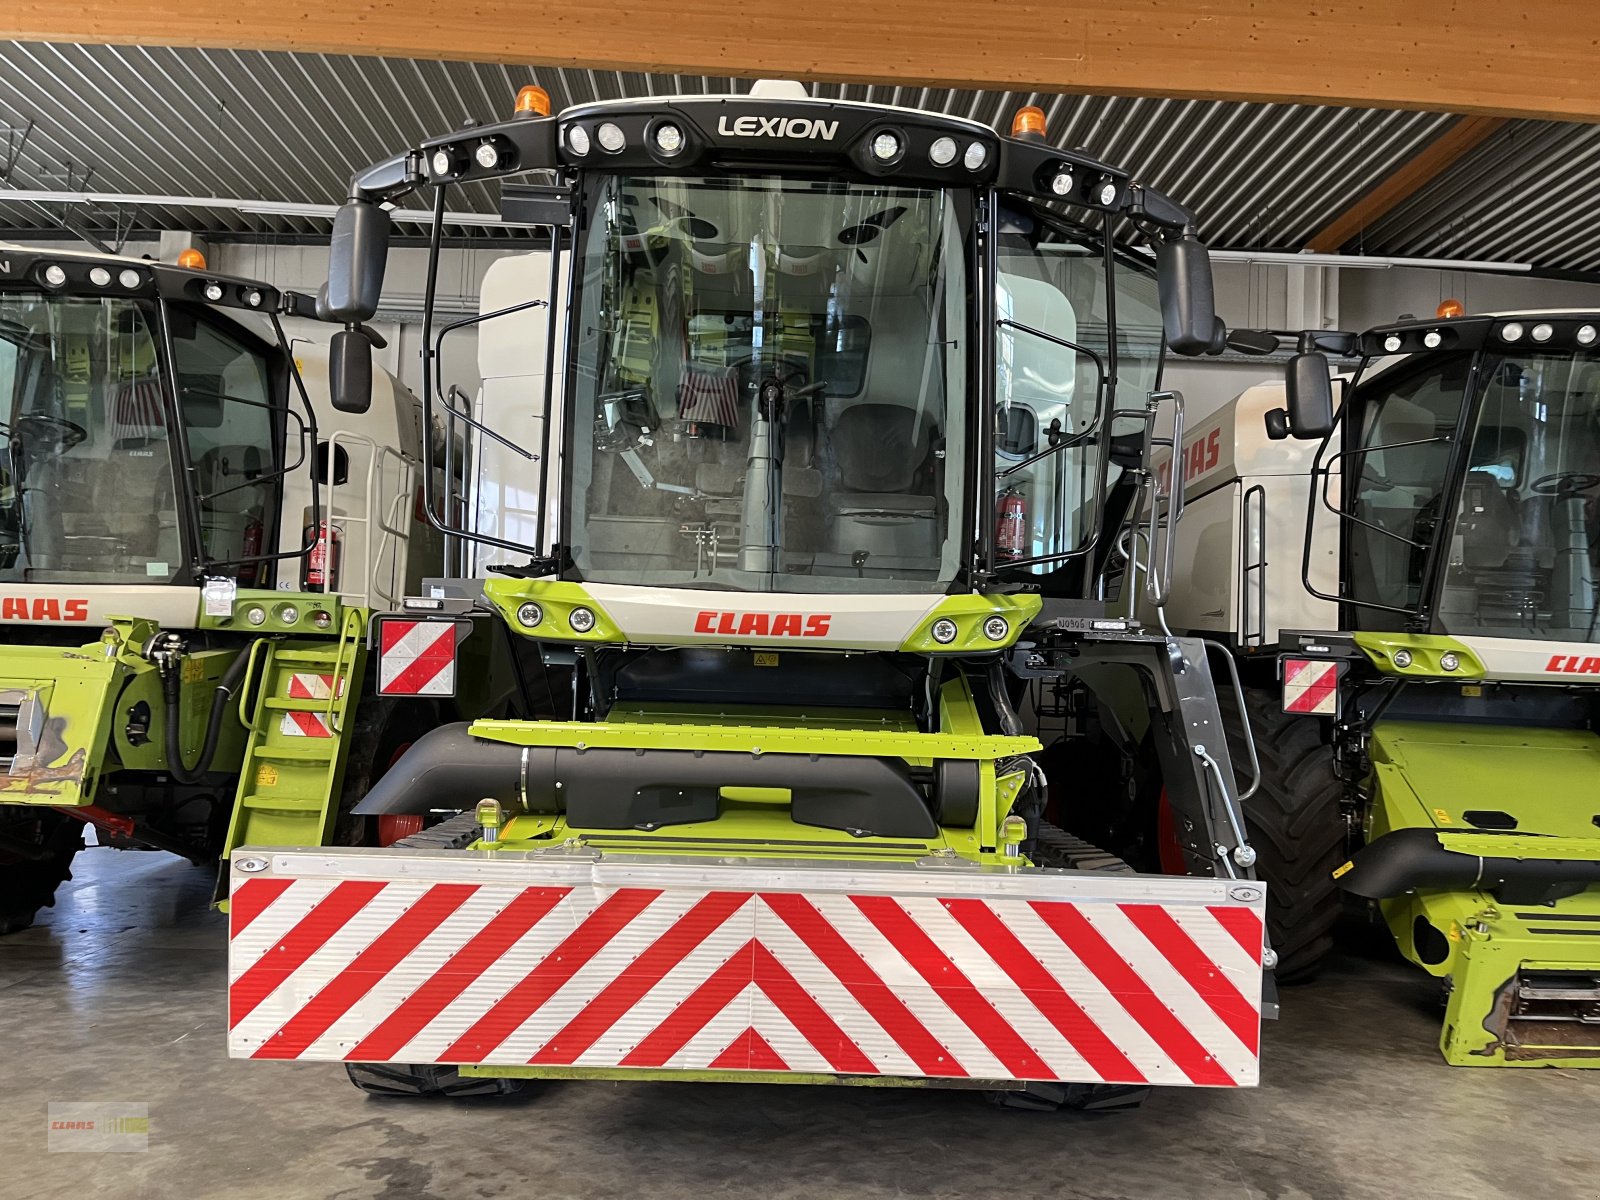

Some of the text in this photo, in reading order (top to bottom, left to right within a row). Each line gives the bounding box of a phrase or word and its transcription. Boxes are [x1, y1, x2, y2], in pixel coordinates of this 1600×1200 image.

[717, 116, 839, 140] LEXION
[2, 597, 89, 621] AAS
[694, 611, 832, 637] CLAAS
[1544, 655, 1600, 673] CLA
